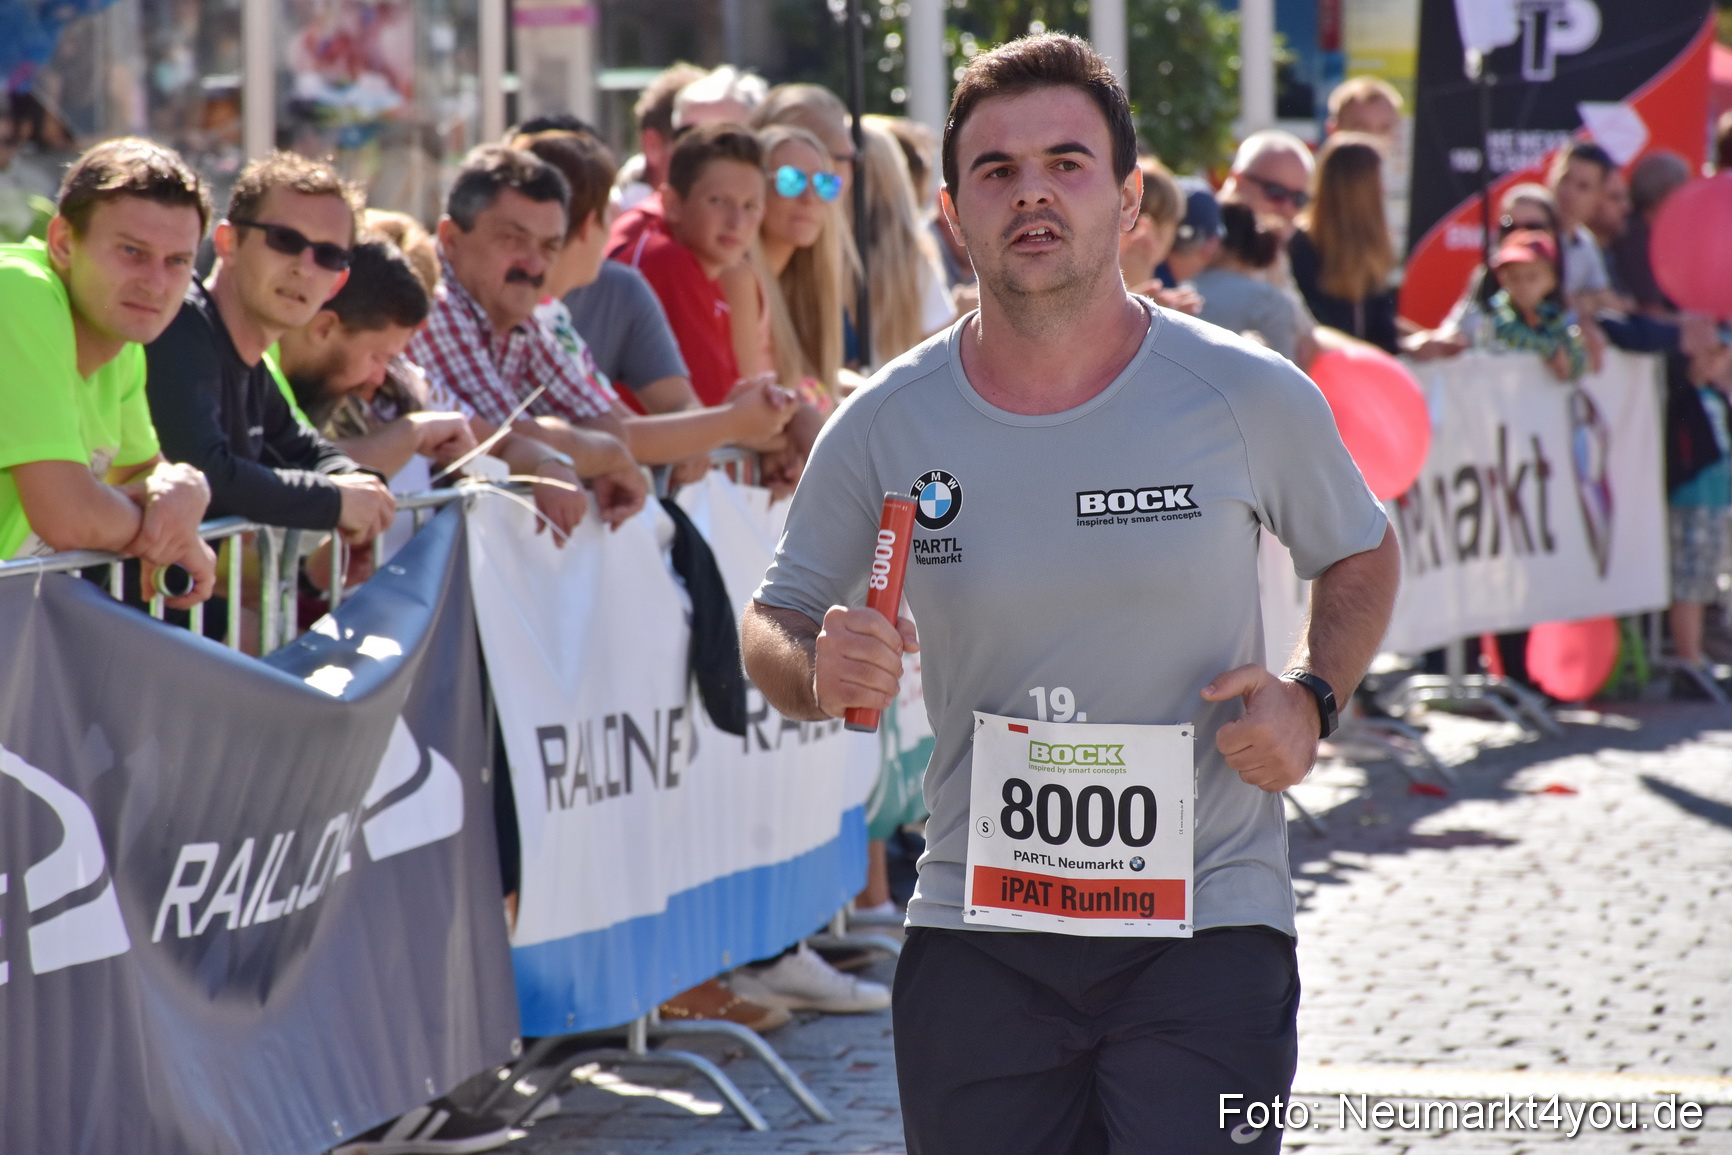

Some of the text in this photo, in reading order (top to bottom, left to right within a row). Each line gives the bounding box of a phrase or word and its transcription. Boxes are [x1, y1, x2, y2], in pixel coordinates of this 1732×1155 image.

[914, 471, 959, 492] BMW
[1076, 484, 1199, 517] BOCK
[1076, 510, 1203, 528] inspired by smart concepts
[913, 537, 963, 554] PARTL
[870, 529, 896, 591] 8000
[915, 553, 963, 566] Neumarkt
[1028, 686, 1087, 723] 19.
[1029, 740, 1126, 766] BOCK
[1028, 763, 1127, 776] inspired by smart concepts
[1000, 777, 1158, 848] 8000
[1013, 850, 1124, 870] PARTL Neumarkt
[1001, 876, 1053, 907] iPAT
